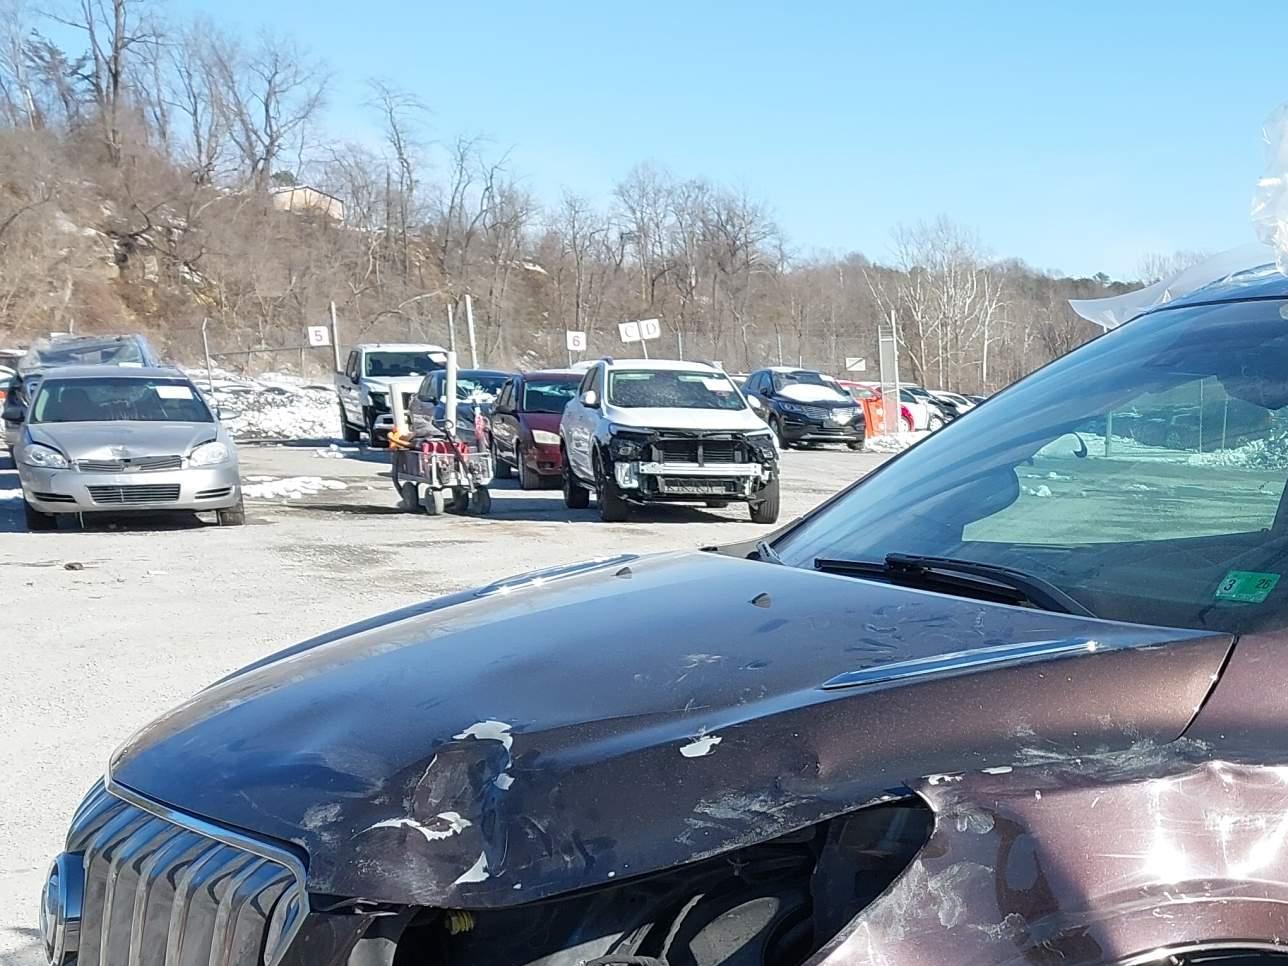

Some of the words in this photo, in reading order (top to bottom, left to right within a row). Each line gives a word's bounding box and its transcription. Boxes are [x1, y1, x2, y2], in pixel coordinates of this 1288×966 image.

[624, 325, 635, 338] C
[646, 322, 657, 336] D
[314, 330, 323, 342] 5
[572, 335, 580, 347] 6
[1223, 578, 1237, 592] 3
[1255, 578, 1272, 589] 26
